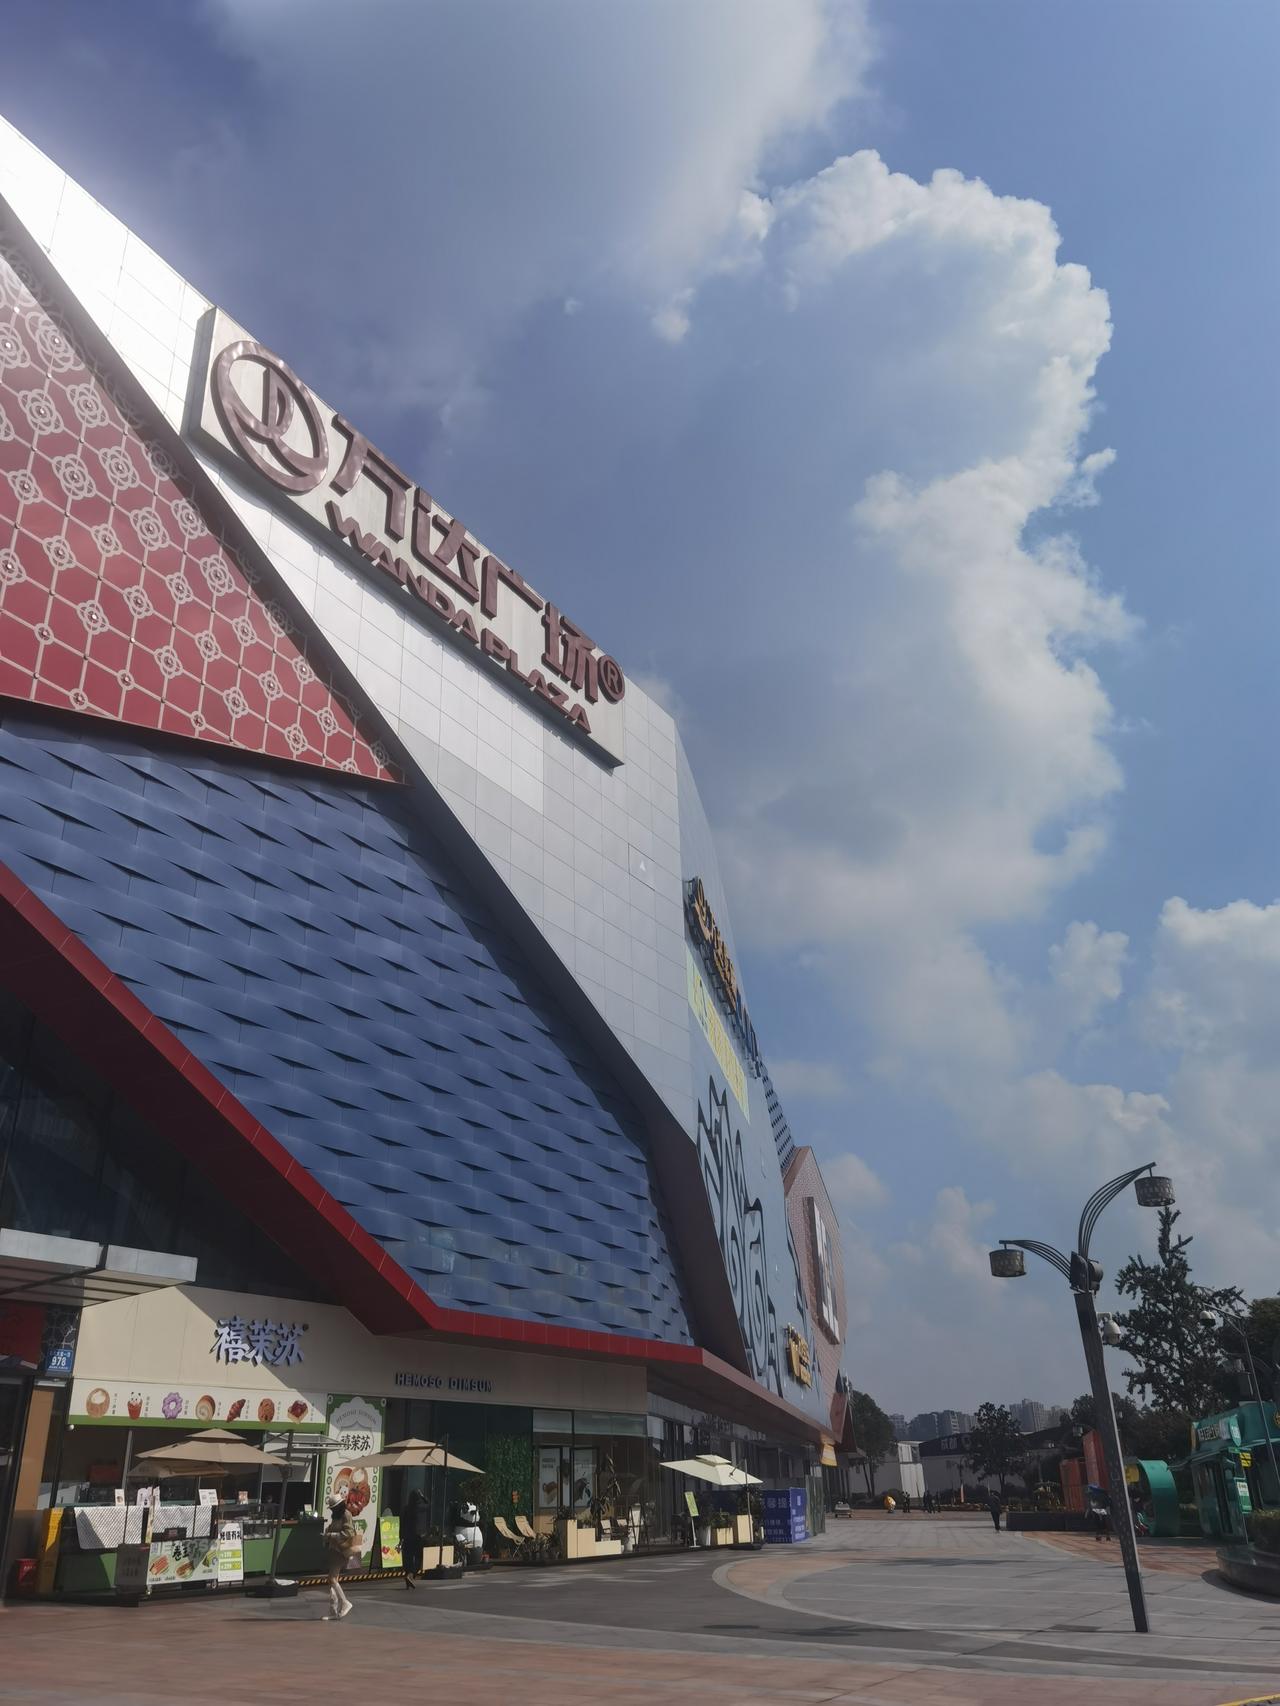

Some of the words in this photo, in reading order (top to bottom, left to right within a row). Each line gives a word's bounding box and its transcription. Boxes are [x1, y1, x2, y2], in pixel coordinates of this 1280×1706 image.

[325, 501, 480, 644] WANDA
[481, 628, 592, 735] PLAZA
[329, 413, 599, 703] 万达广场
[209, 1315, 305, 1368] 禧茉苏
[394, 1372, 444, 1389] HEMOSO
[448, 1377, 494, 1393] DIMSUN
